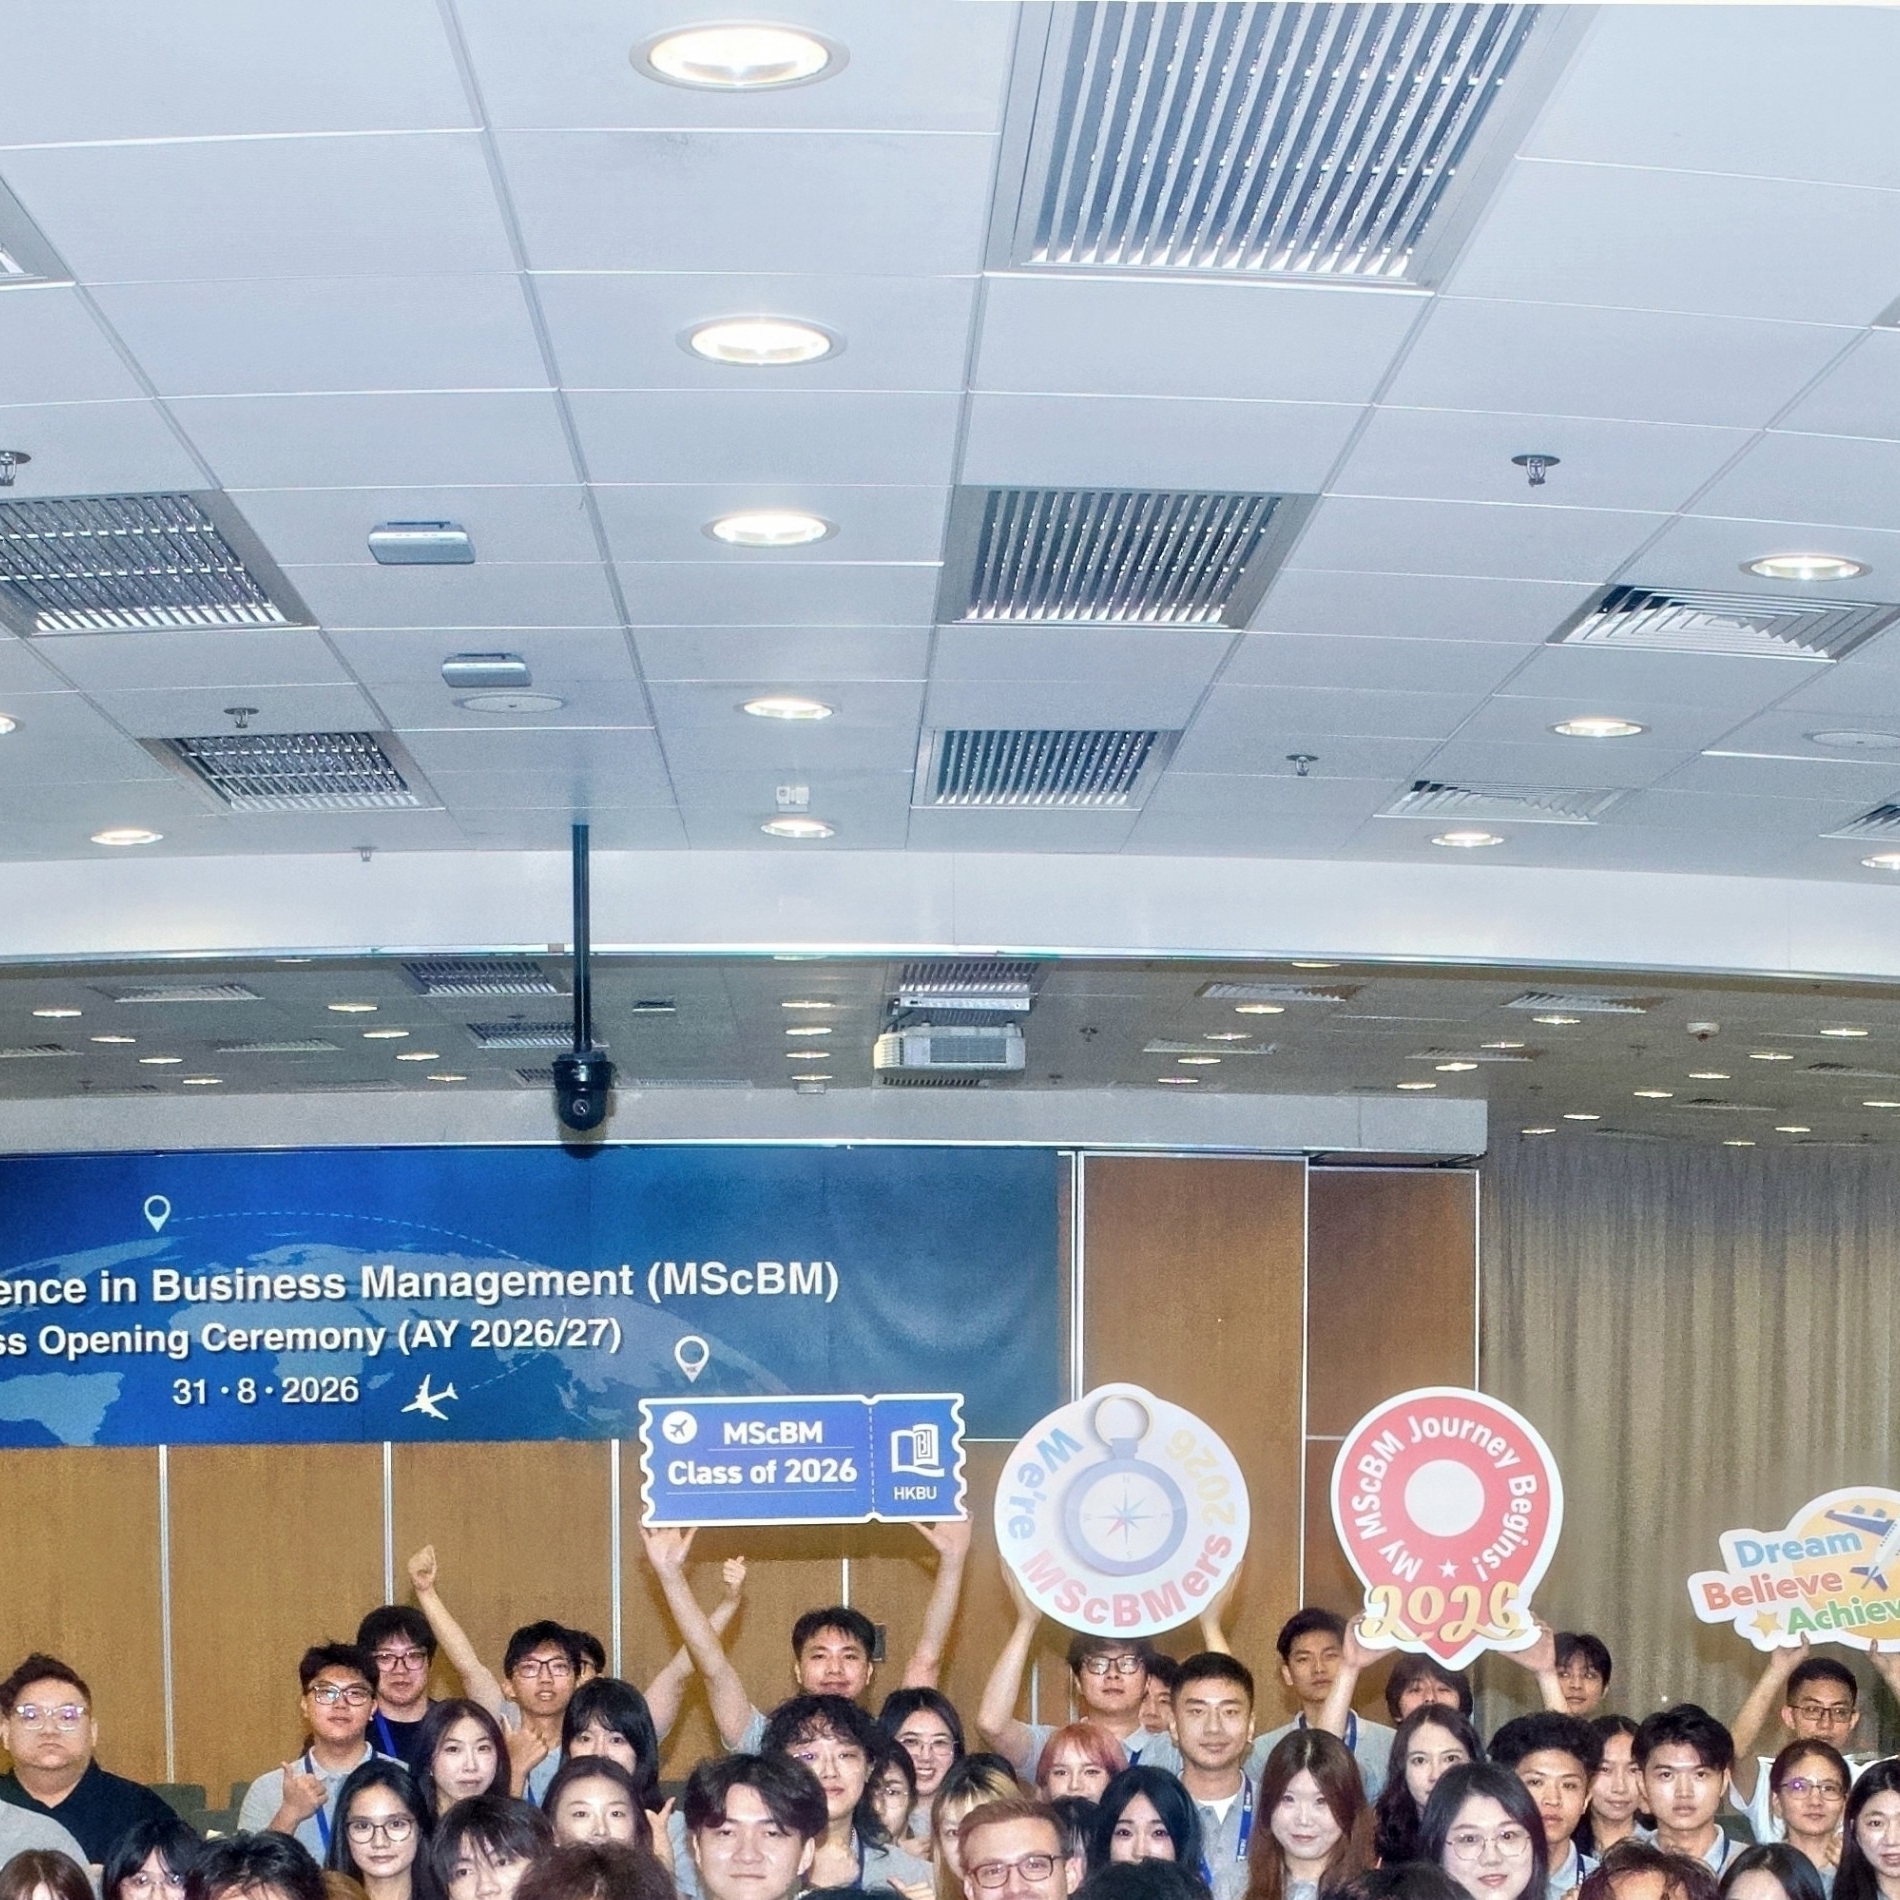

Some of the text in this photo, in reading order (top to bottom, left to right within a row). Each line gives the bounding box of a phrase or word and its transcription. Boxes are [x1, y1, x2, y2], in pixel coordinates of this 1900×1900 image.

[100, 1272, 136, 1302] in
[151, 1266, 346, 1302] Business
[360, 1264, 635, 1307] Management
[646, 1260, 841, 1303] (MScBM)
[38, 1325, 189, 1362] Opening
[201, 1321, 386, 1357] Ceremony
[398, 1318, 460, 1355] (AY
[469, 1316, 624, 1354] 2026/27)
[280, 1376, 359, 1402] 2026
[723, 1421, 823, 1445] MScBM
[667, 1458, 858, 1485] Class of 2026
[893, 1485, 938, 1500] HKBU
[1008, 1428, 1084, 1540] We're
[1165, 1429, 1236, 1527] 2026
[1351, 1415, 1538, 1583] My MScBM Journey Begins!
[1733, 1531, 1863, 1569] Dream
[1019, 1533, 1233, 1628] MScBMers
[1701, 1571, 1844, 1612] Believe
[1359, 1580, 1528, 1643] 2026
